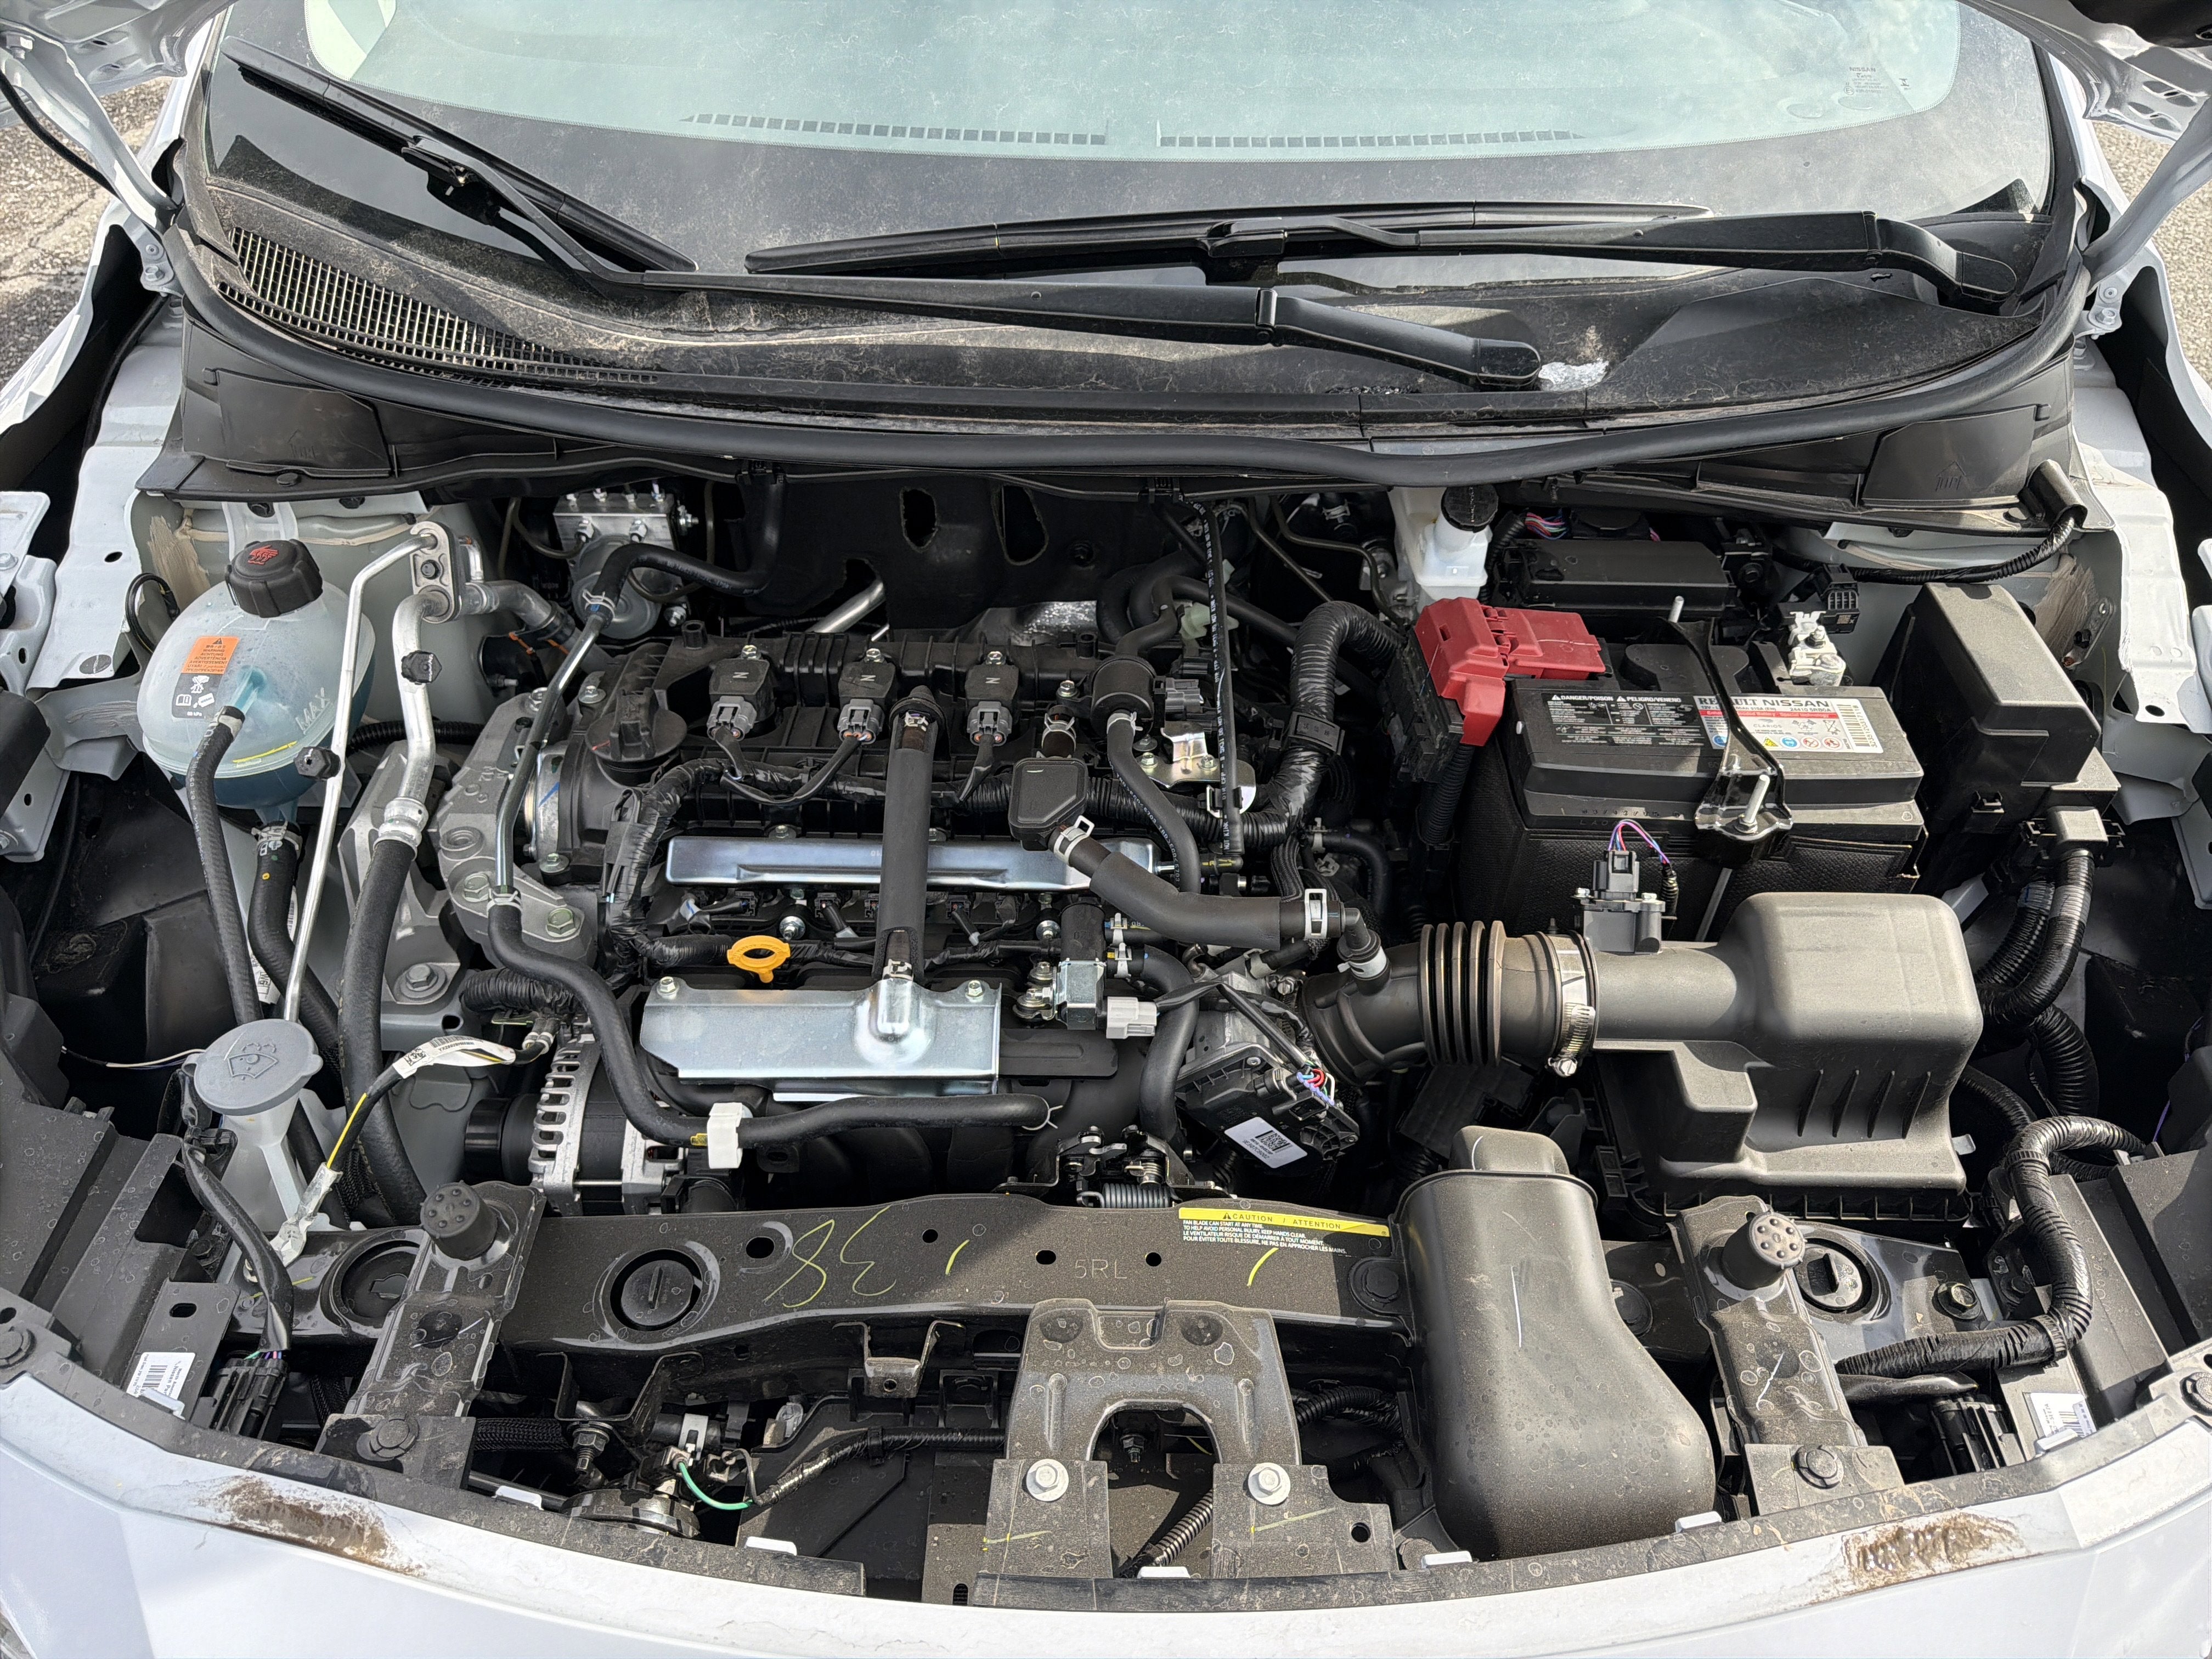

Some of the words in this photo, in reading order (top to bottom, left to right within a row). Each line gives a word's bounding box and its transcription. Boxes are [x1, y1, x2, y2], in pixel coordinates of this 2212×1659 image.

[1763, 699, 1830, 708] NISSAN
[1233, 1214, 1273, 1222] CAUTION
[1293, 1220, 1341, 1229] ATTENTION
[1287, 1243, 1319, 1251] APPROCHER
